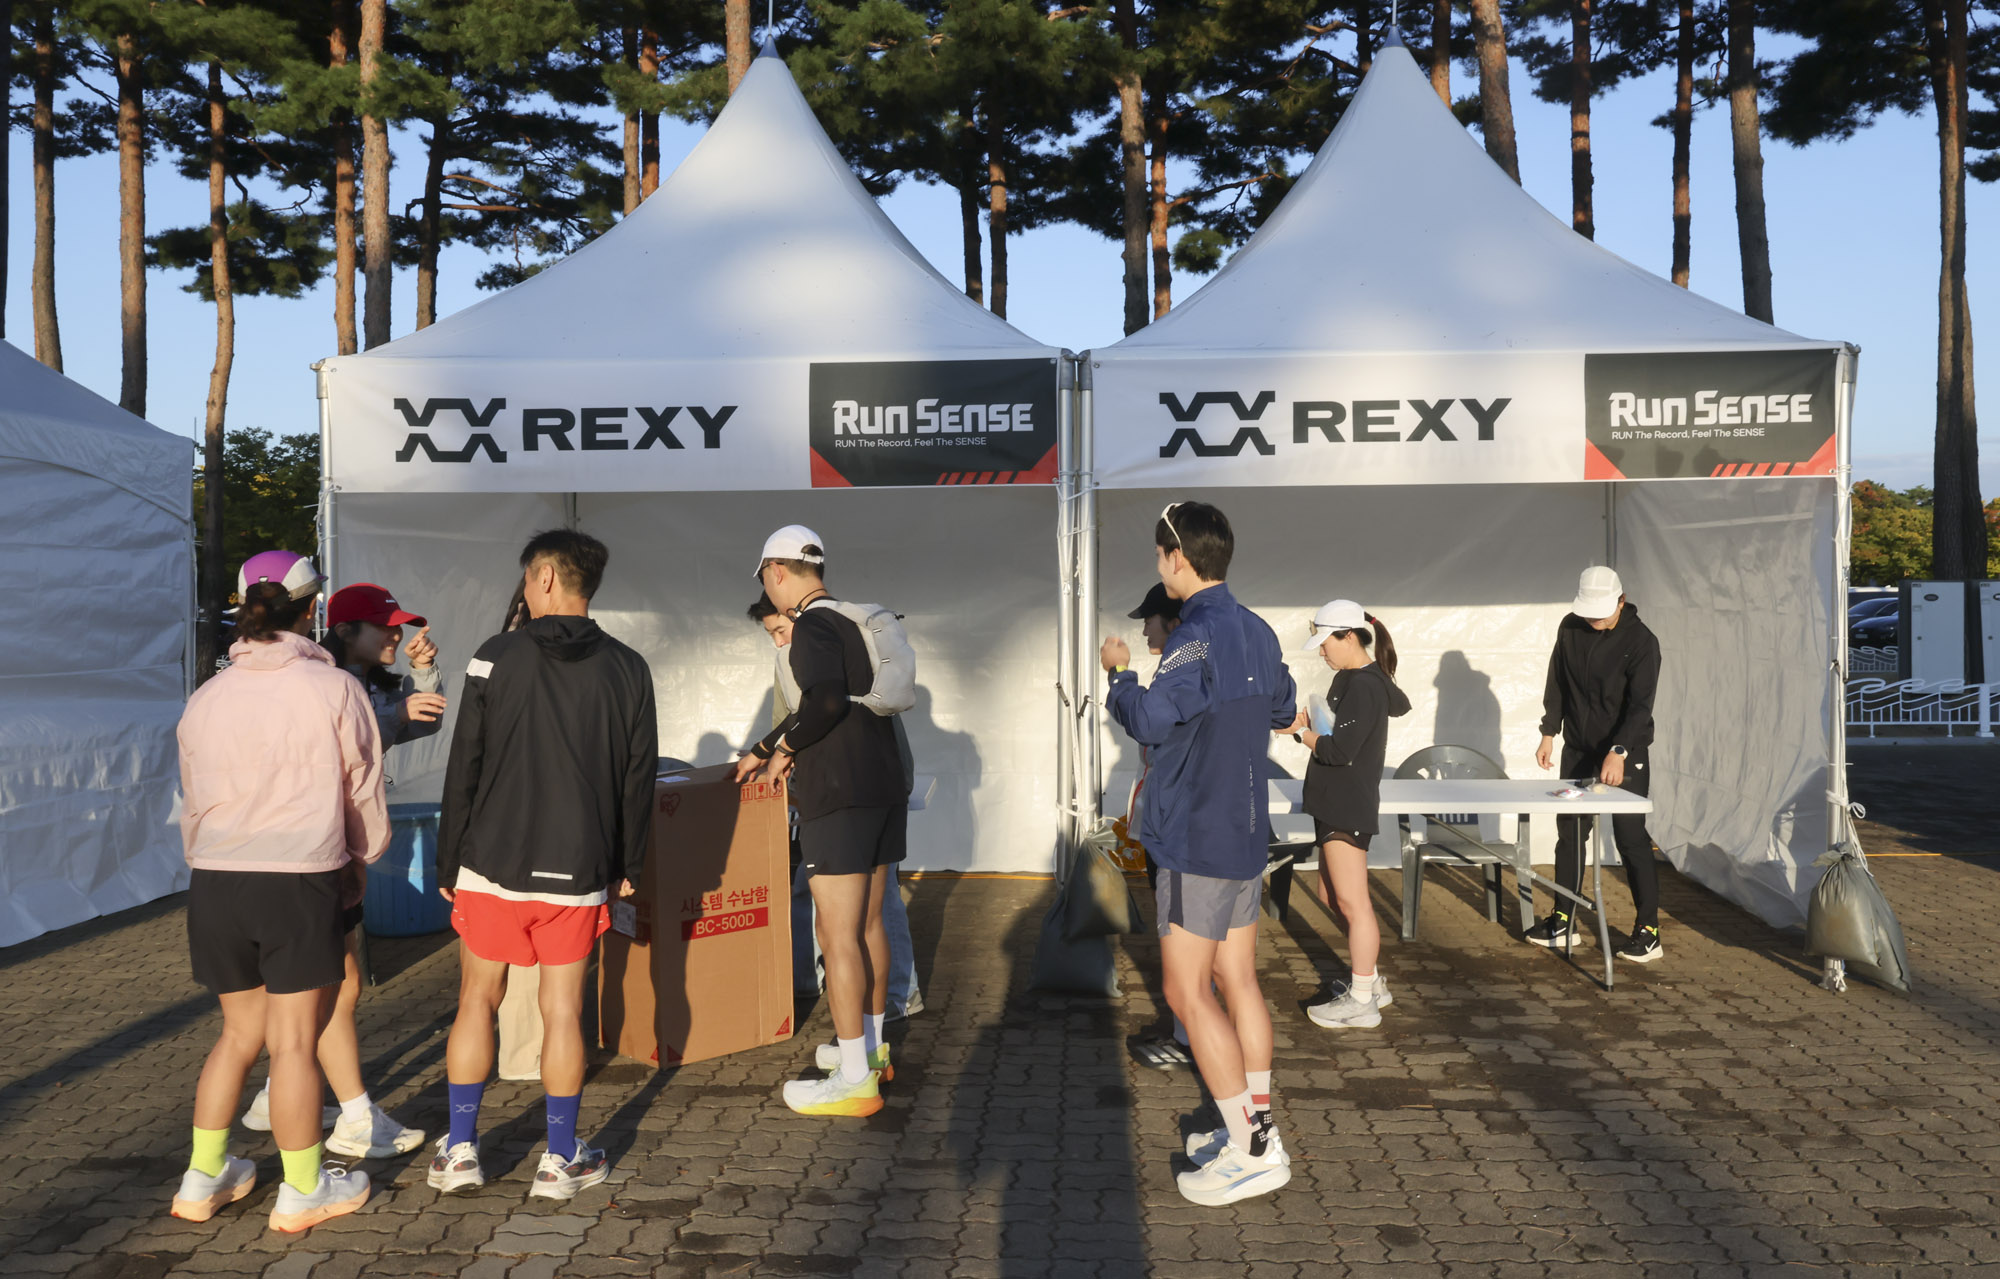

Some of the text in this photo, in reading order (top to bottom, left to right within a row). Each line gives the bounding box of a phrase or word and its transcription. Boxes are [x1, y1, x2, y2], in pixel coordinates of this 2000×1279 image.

[522, 405, 738, 451] REXY
[1292, 397, 1513, 444] REXY
[1612, 427, 1765, 440] RUN The Record, Feel The SENSE
[835, 437, 987, 448] RUN The Record, Feel The SENSE
[680, 885, 769, 915] 시스템 수납함
[695, 912, 755, 936] BC-500D
